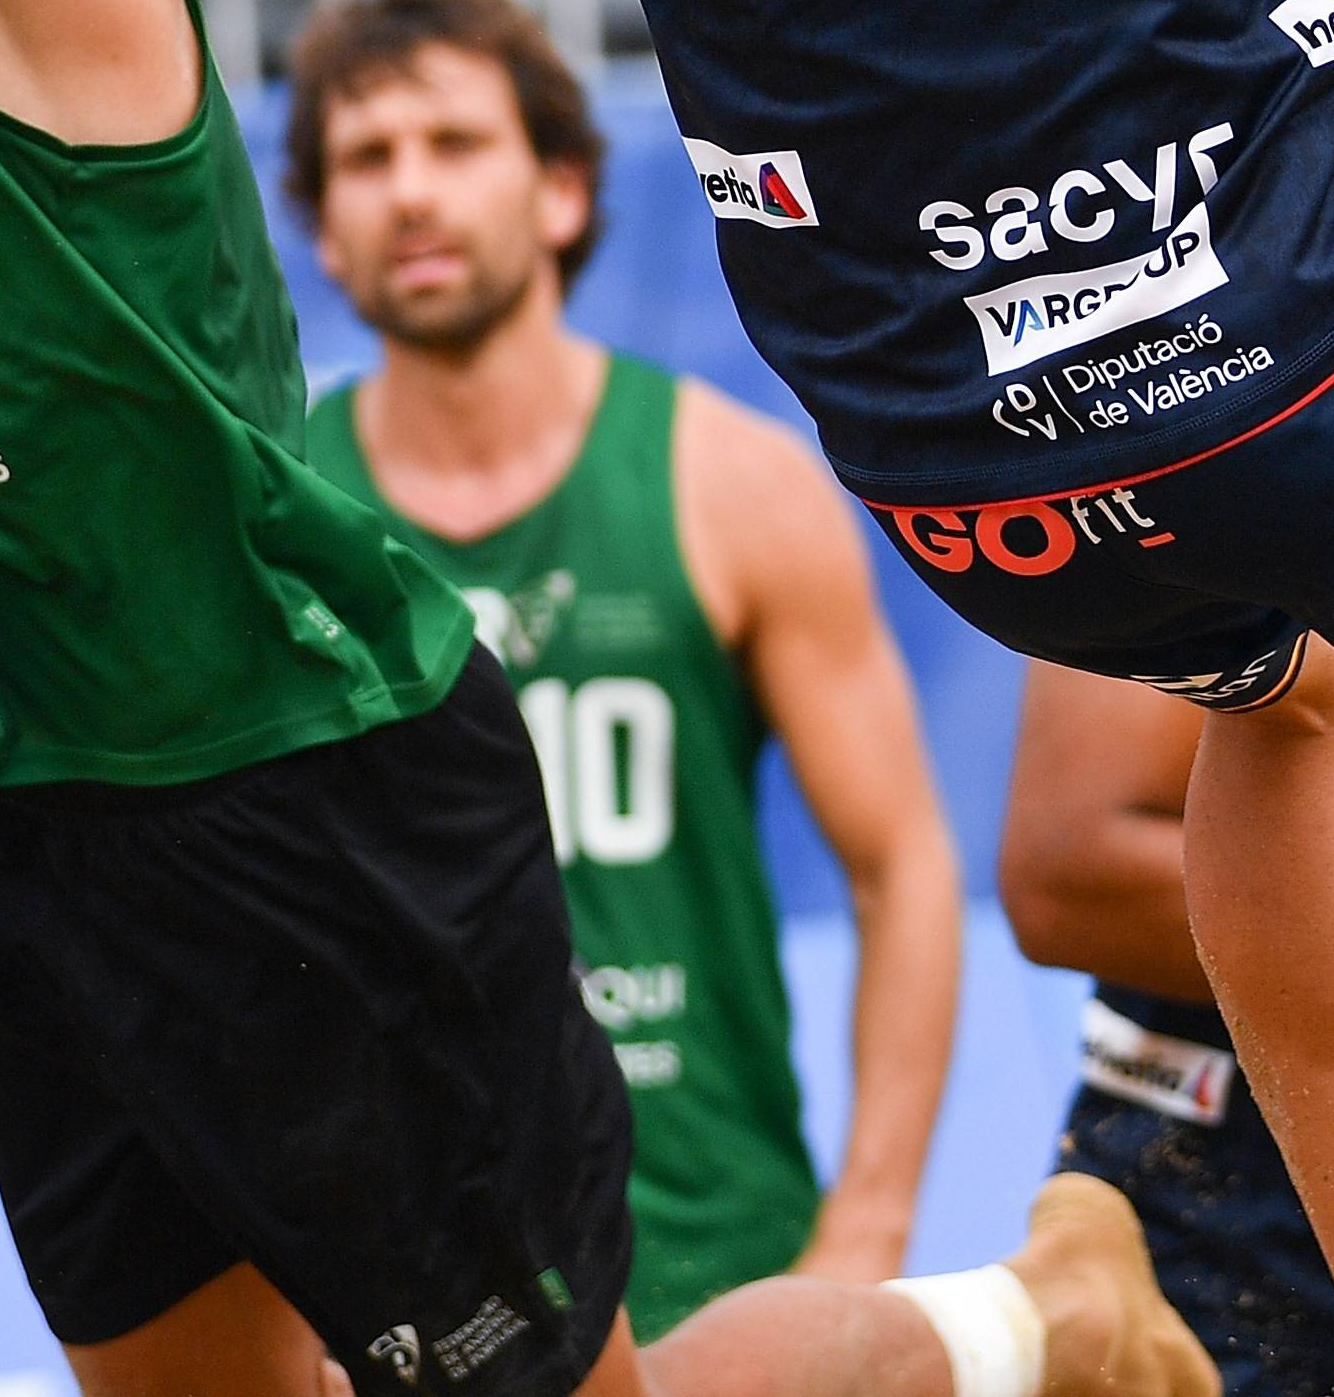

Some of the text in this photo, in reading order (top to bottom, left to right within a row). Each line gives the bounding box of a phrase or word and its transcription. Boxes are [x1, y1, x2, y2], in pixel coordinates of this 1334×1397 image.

[1062, 313, 1223, 395] Diputació
[1088, 343, 1276, 429] de València
[518, 677, 674, 865] 10
